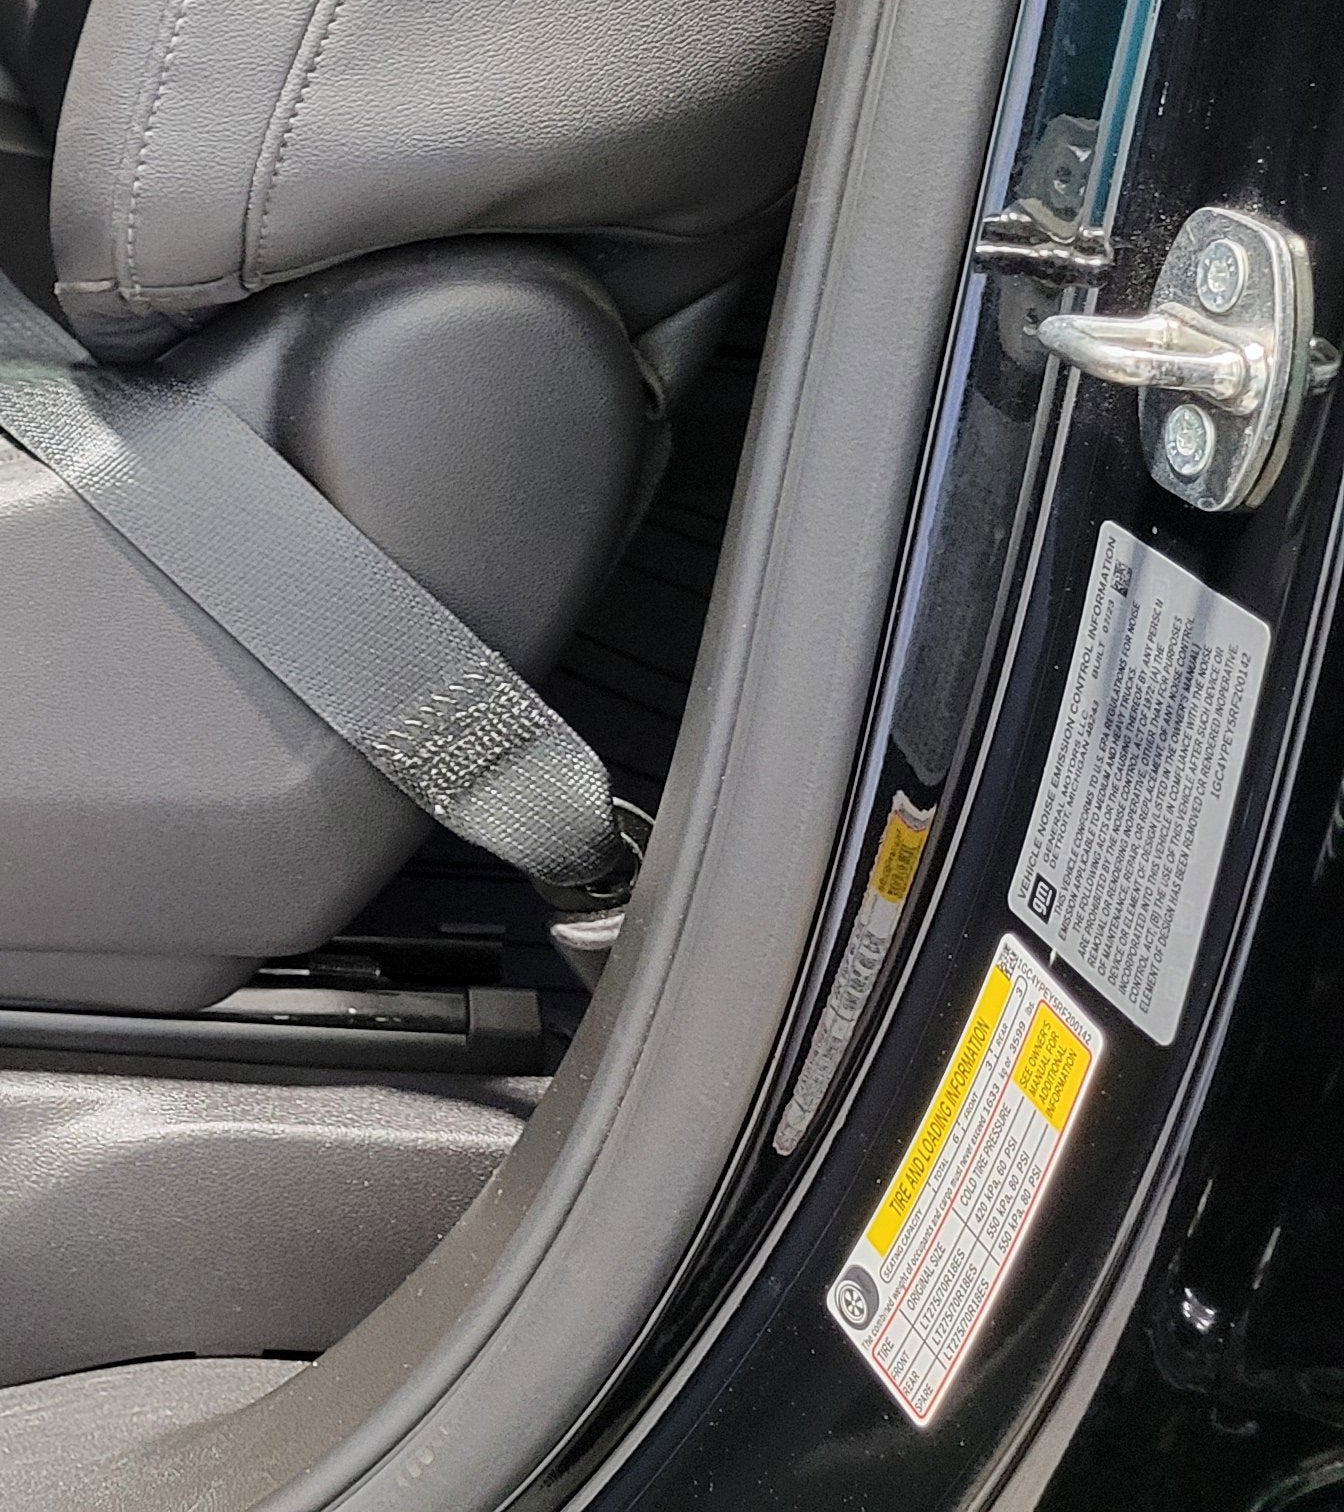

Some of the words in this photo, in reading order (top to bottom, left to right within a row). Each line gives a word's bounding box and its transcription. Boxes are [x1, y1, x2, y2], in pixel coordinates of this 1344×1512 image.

[1126, 600, 1141, 635] NOISE
[1090, 640, 1105, 681] BUILT
[1120, 632, 1133, 658] FOR
[1152, 641, 1165, 666] THE
[1175, 614, 1195, 669] CONTROL
[1197, 643, 1212, 680] NOISE
[1103, 656, 1128, 732] REGULATIONS
[1148, 664, 1161, 684] (A)
[1167, 666, 1183, 703] NOISE
[1192, 678, 1205, 703] THE
[1203, 664, 1221, 707] DEVICE
[1017, 837, 1043, 902] VEHICLE
[1036, 789, 1057, 838] NOISE
[1049, 715, 1076, 790] EMISSION
[1068, 641, 1094, 716] CONTROL
[1086, 534, 1117, 641] INFORMATION
[1110, 709, 1126, 747] HEAVY
[1161, 701, 1175, 727] ANY
[1185, 700, 1199, 732] WITH
[1195, 705, 1211, 739] SUCH
[1097, 729, 1110, 754] EPA
[1104, 744, 1118, 771] AND
[1132, 725, 1145, 751] ACT
[1187, 736, 1204, 776] AFTER
[1042, 799, 1065, 865] GENERAL
[1060, 738, 1081, 798] MOTORS
[1076, 707, 1089, 737] LLC
[1066, 738, 1090, 809] MICHIGAN
[1119, 749, 1139, 803] CONTROL
[1167, 730, 1192, 803] COMPLIANCE
[1093, 768, 1112, 813] MEDIUM
[1175, 773, 1195, 823] VEHICLE
[1072, 788, 1095, 850] CONFORMS
[1107, 945, 1125, 986] DEVICE
[1122, 877, 1143, 930] ELEMENT
[1140, 820, 1158, 864] DESIGN
[1164, 743, 1177, 768] THE
[1181, 641, 1203, 695] MANUAL)
[1110, 800, 1126, 836] NOISE
[1169, 819, 1184, 849] THIS
[1071, 826, 1096, 893] APPLICABLE
[1105, 833, 1118, 858] THE
[1153, 814, 1172, 862] VEHICLE
[1060, 847, 1079, 893] VEHICLE
[1138, 961, 1160, 1014] ELEMENT
[1157, 903, 1175, 947] DESIGN
[1167, 879, 1181, 906] HAS
[1174, 848, 1189, 882] BEEN
[1182, 794, 1203, 851] REMOVED
[1199, 716, 1222, 779] RENDERED
[1146, 859, 1160, 886] THIS
[1159, 862, 1173, 889] USE
[1053, 890, 1067, 917] THIS
[1057, 890, 1079, 942] EMISSION
[1083, 871, 1108, 937] PROHIBITED
[1139, 884, 1154, 914] INTO
[1148, 908, 1162, 929] (B)
[1153, 886, 1167, 911] THE
[1077, 934, 1090, 960] ARE
[1117, 910, 1147, 996] INCORPORATED
[1128, 951, 1150, 1005] CONTROL
[1018, 1063, 1033, 1090] SEE
[1027, 1051, 1051, 1098] MANUAL
[1045, 1028, 1060, 1057] FOR
[1037, 1040, 1068, 1106] ADDITIONAL
[1043, 1046, 1078, 1119] INFORMATION
[888, 1181, 912, 1219] TIRE
[903, 1153, 926, 1190] AND
[916, 1098, 953, 1163] LOADING
[943, 1013, 990, 1107] INFORMATION
[883, 1243, 904, 1279] SEATING
[900, 1206, 924, 1248] CAPACITY
[932, 1154, 950, 1184] TOTAL
[962, 1090, 979, 1121] FRONT
[994, 1019, 1009, 1049] REAR
[860, 1332, 874, 1352] The
[869, 1295, 895, 1337] combined
[890, 1270, 911, 1303] weight
[908, 1222, 936, 1269] occupants
[929, 1206, 942, 1228] and
[938, 1184, 956, 1215] cargo
[948, 1163, 963, 1189] must
[959, 1142, 973, 1169] never
[968, 1112, 986, 1146] exceed
[981, 1080, 1000, 1116] 1633
[1008, 1018, 1027, 1055] 3599
[876, 1335, 895, 1364] TIRE
[904, 1261, 936, 1314] ORIGINAL
[928, 1238, 947, 1269] SIZE
[958, 1174, 978, 1209] COLD
[971, 1152, 988, 1181] TIRE
[981, 1099, 1012, 1159] PRESSURE
[889, 1349, 911, 1382] FRONT
[918, 1245, 966, 1332] LT275/70R18ES
[972, 1198, 989, 1227] 420
[983, 1172, 1001, 1204] kPa,
[1003, 1132, 1019, 1161] PSI
[901, 1368, 920, 1397] REAR
[930, 1260, 979, 1348] LT275/70R18ES
[984, 1213, 1001, 1242] 550
[995, 1187, 1013, 1219] kPa,
[1015, 1147, 1031, 1175] PSI
[913, 1381, 934, 1413] SPARE
[942, 1275, 991, 1362] LT275/70R18ES
[996, 1228, 1013, 1257] 550
[1007, 1202, 1025, 1233] kPa,
[1027, 1162, 1043, 1190] PSI
